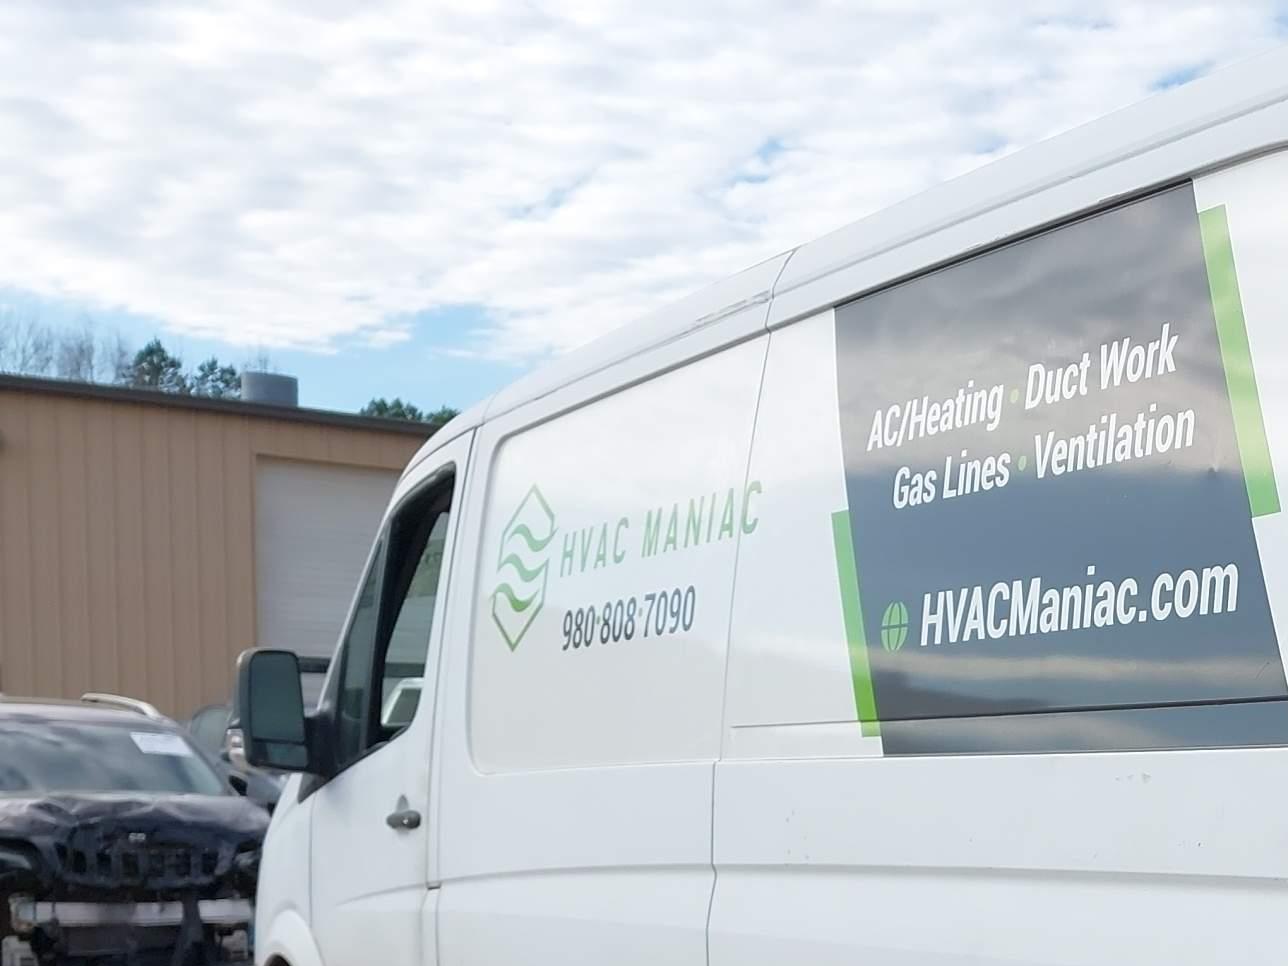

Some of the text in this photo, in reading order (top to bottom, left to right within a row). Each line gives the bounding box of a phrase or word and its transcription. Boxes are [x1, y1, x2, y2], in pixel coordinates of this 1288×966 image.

[865, 322, 1180, 452] AC/Heating Duct Work
[893, 403, 1196, 510] Gas Lines Ventilation
[559, 481, 762, 578] HVAC MANIAC
[919, 561, 1239, 647] HVACManiac.com
